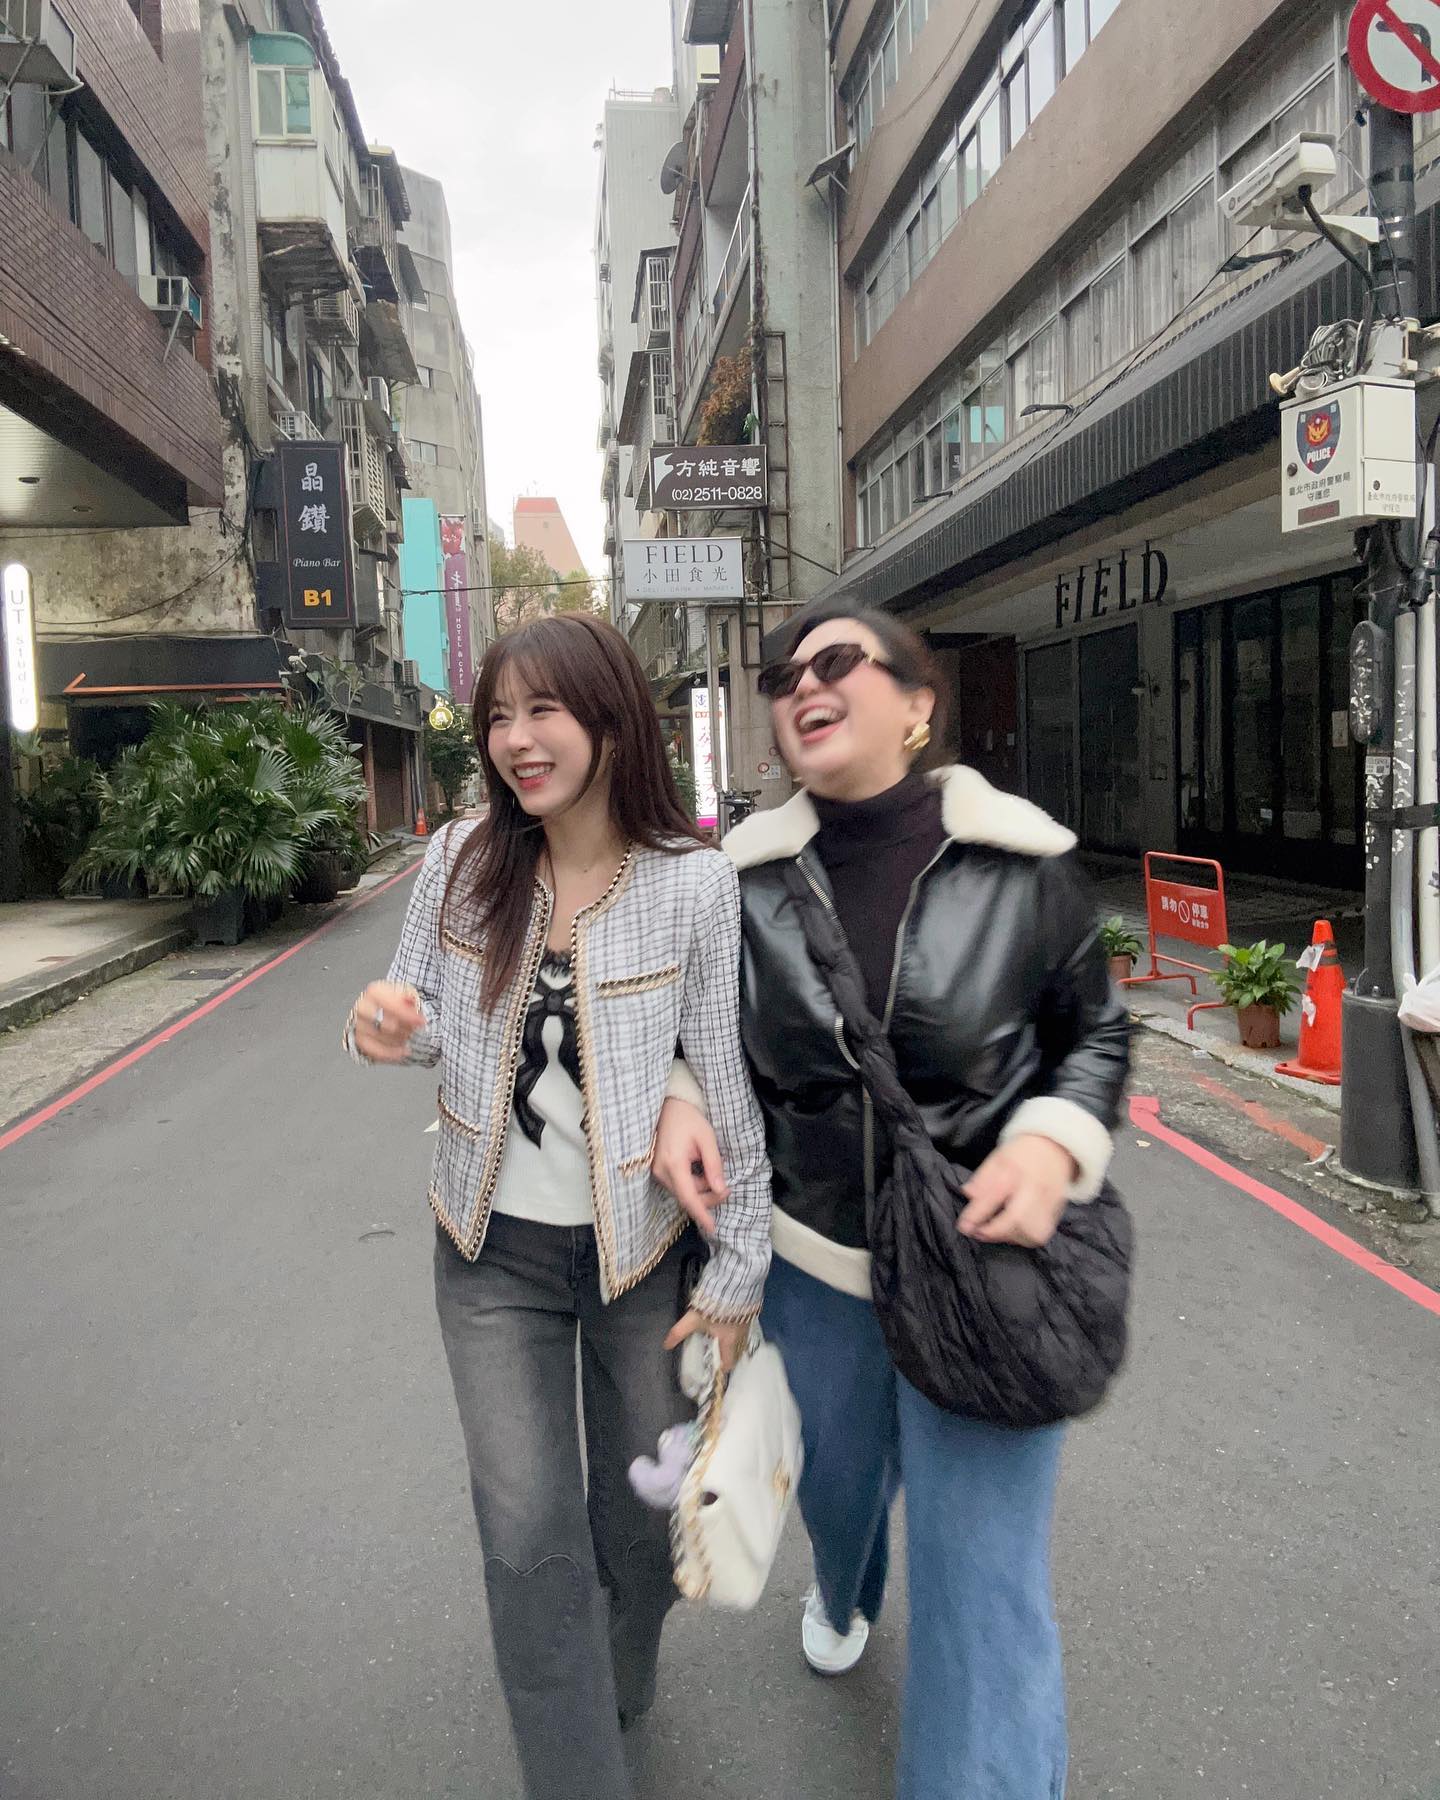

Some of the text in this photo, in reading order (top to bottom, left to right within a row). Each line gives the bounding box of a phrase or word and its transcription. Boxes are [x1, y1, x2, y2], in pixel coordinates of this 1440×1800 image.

[1306, 446, 1332, 465] POLICE
[676, 457, 762, 477] 方純音響
[298, 462, 330, 534] 晶鑽
[671, 486, 763, 502] (02)2511-0828
[293, 557, 342, 567] Piano Bar
[645, 544, 724, 564] FIELD
[643, 566, 728, 584] 小田食光
[1055, 545, 1168, 629] FIELD
[303, 589, 332, 607] B1
[455, 617, 463, 648] HOTEL
